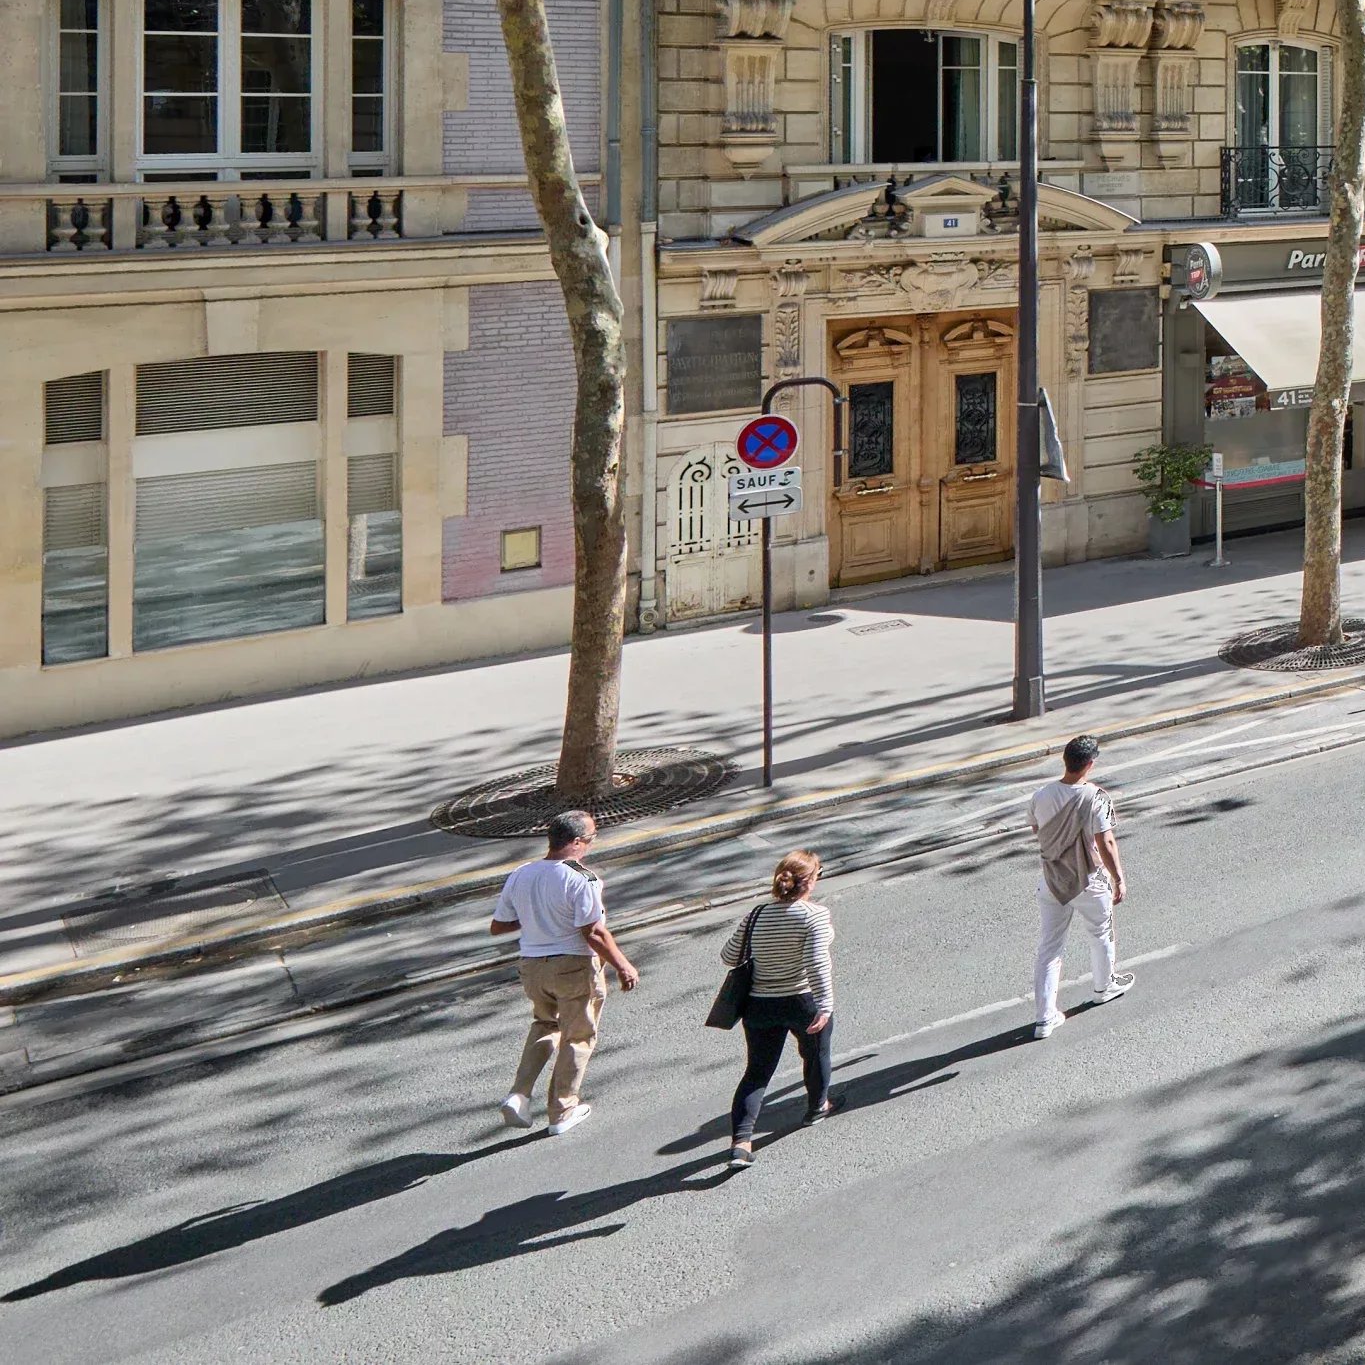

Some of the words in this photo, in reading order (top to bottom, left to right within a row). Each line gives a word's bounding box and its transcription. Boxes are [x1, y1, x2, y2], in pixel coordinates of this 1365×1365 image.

[945, 219, 957, 228] 41
[1277, 390, 1297, 406] 41
[736, 474, 777, 490] SAUF
